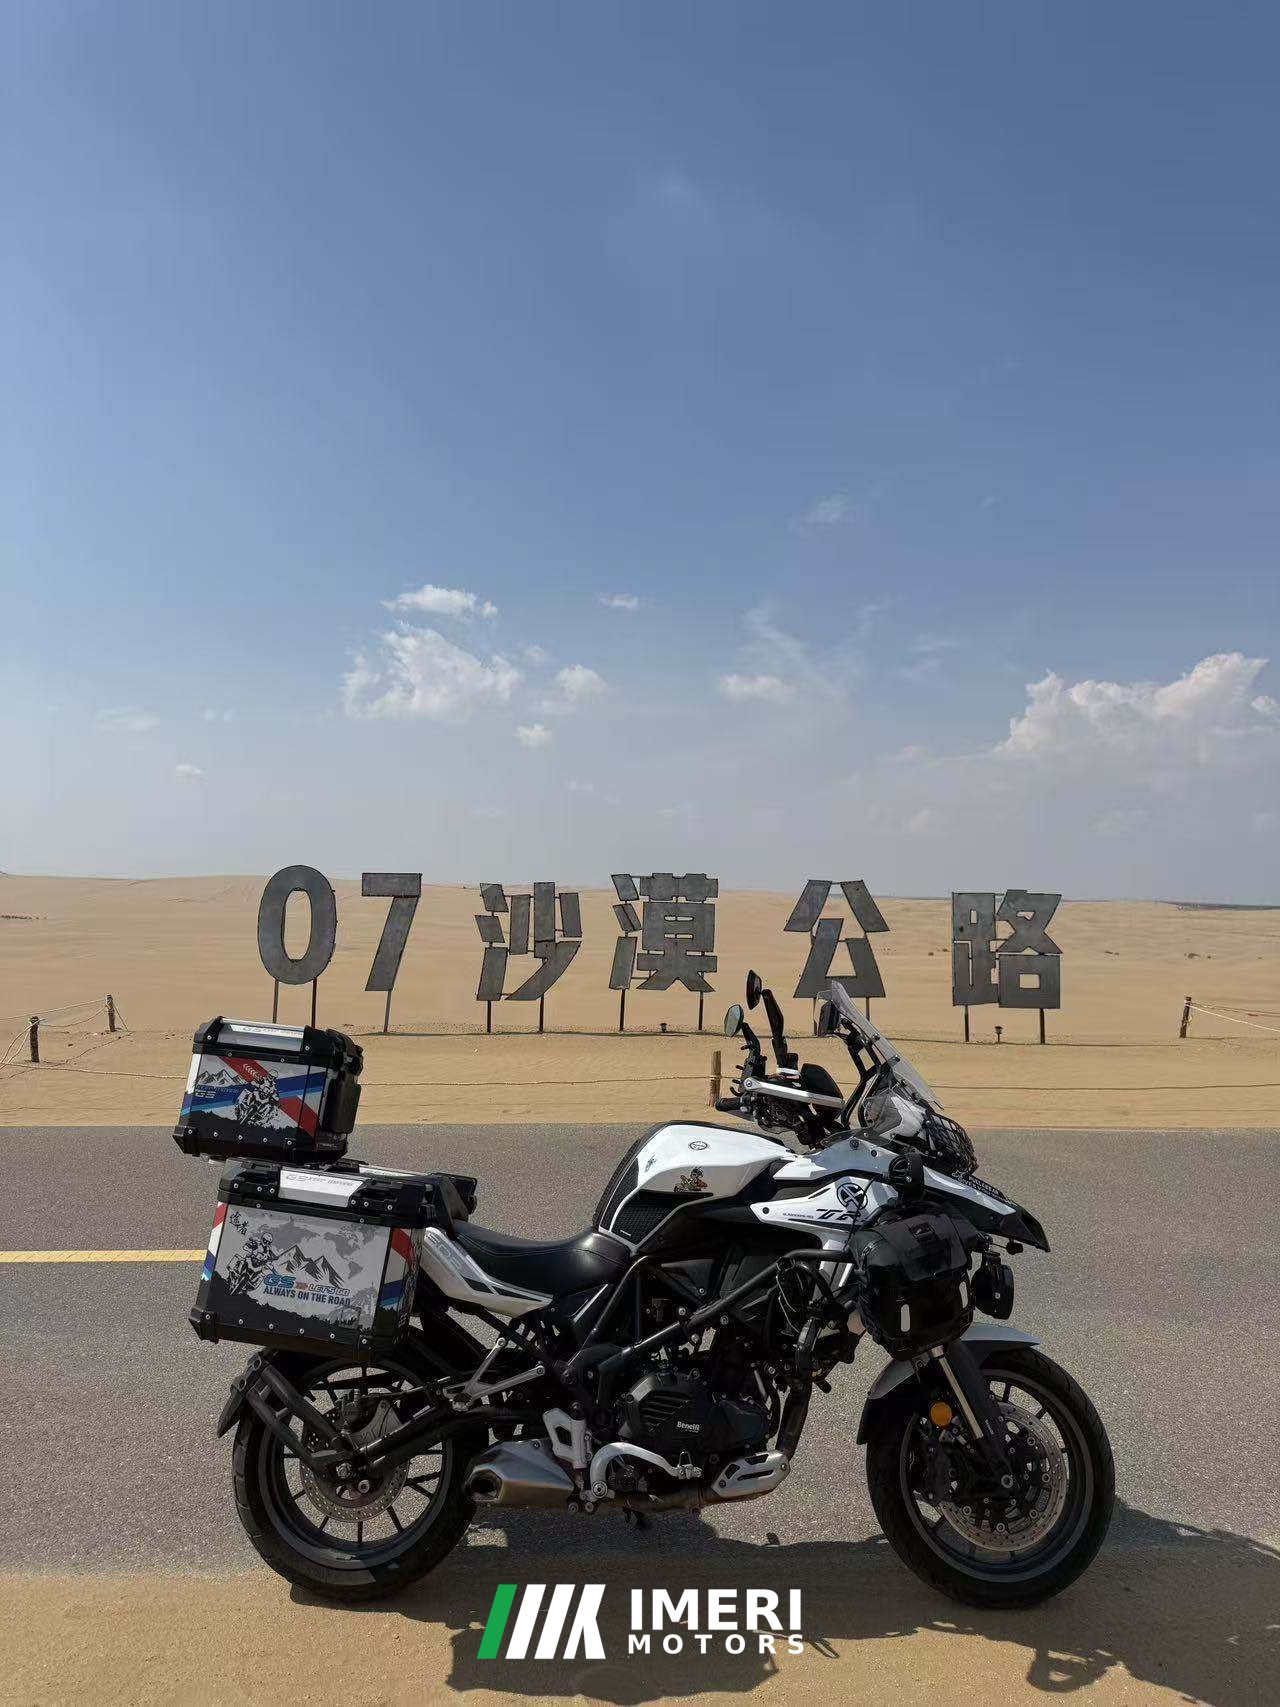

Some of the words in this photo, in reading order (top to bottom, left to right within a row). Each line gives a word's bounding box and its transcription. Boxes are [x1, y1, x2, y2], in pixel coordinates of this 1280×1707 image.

[263, 1285, 297, 1299] ALWAYS
[297, 1290, 310, 1301] ON
[311, 1292, 327, 1304] THE
[327, 1294, 352, 1306] ROAD
